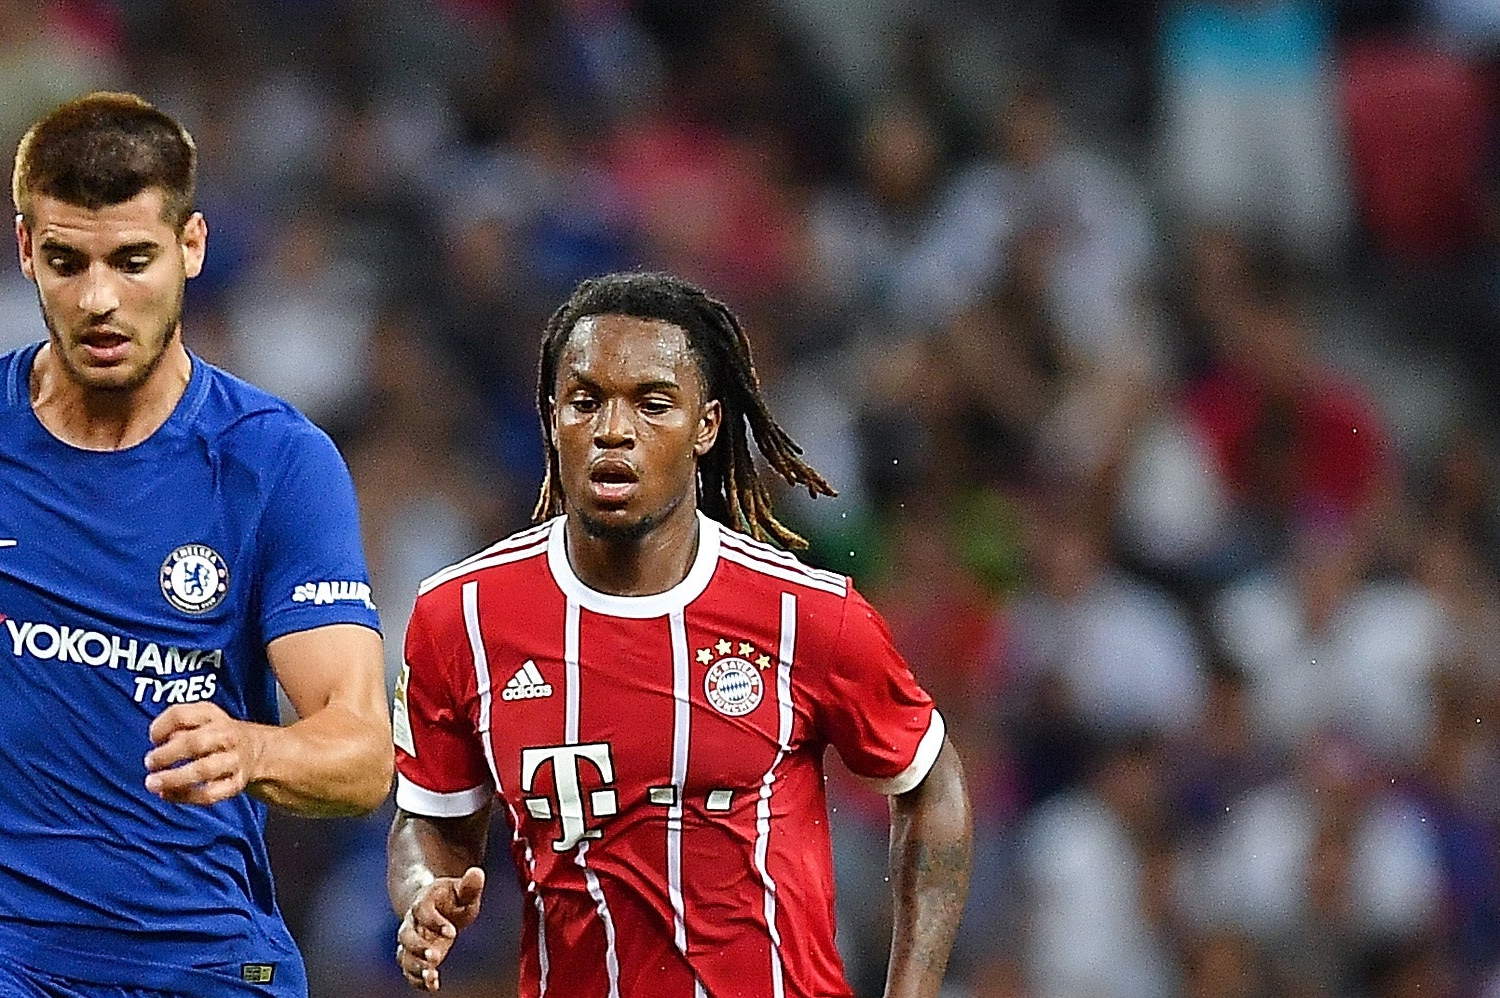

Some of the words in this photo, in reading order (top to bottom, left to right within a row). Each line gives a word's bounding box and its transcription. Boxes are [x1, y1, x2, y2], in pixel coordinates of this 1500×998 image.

[5, 619, 222, 676] YOKOHAMA
[134, 673, 217, 703] TYRES
[501, 684, 553, 701] adidas
